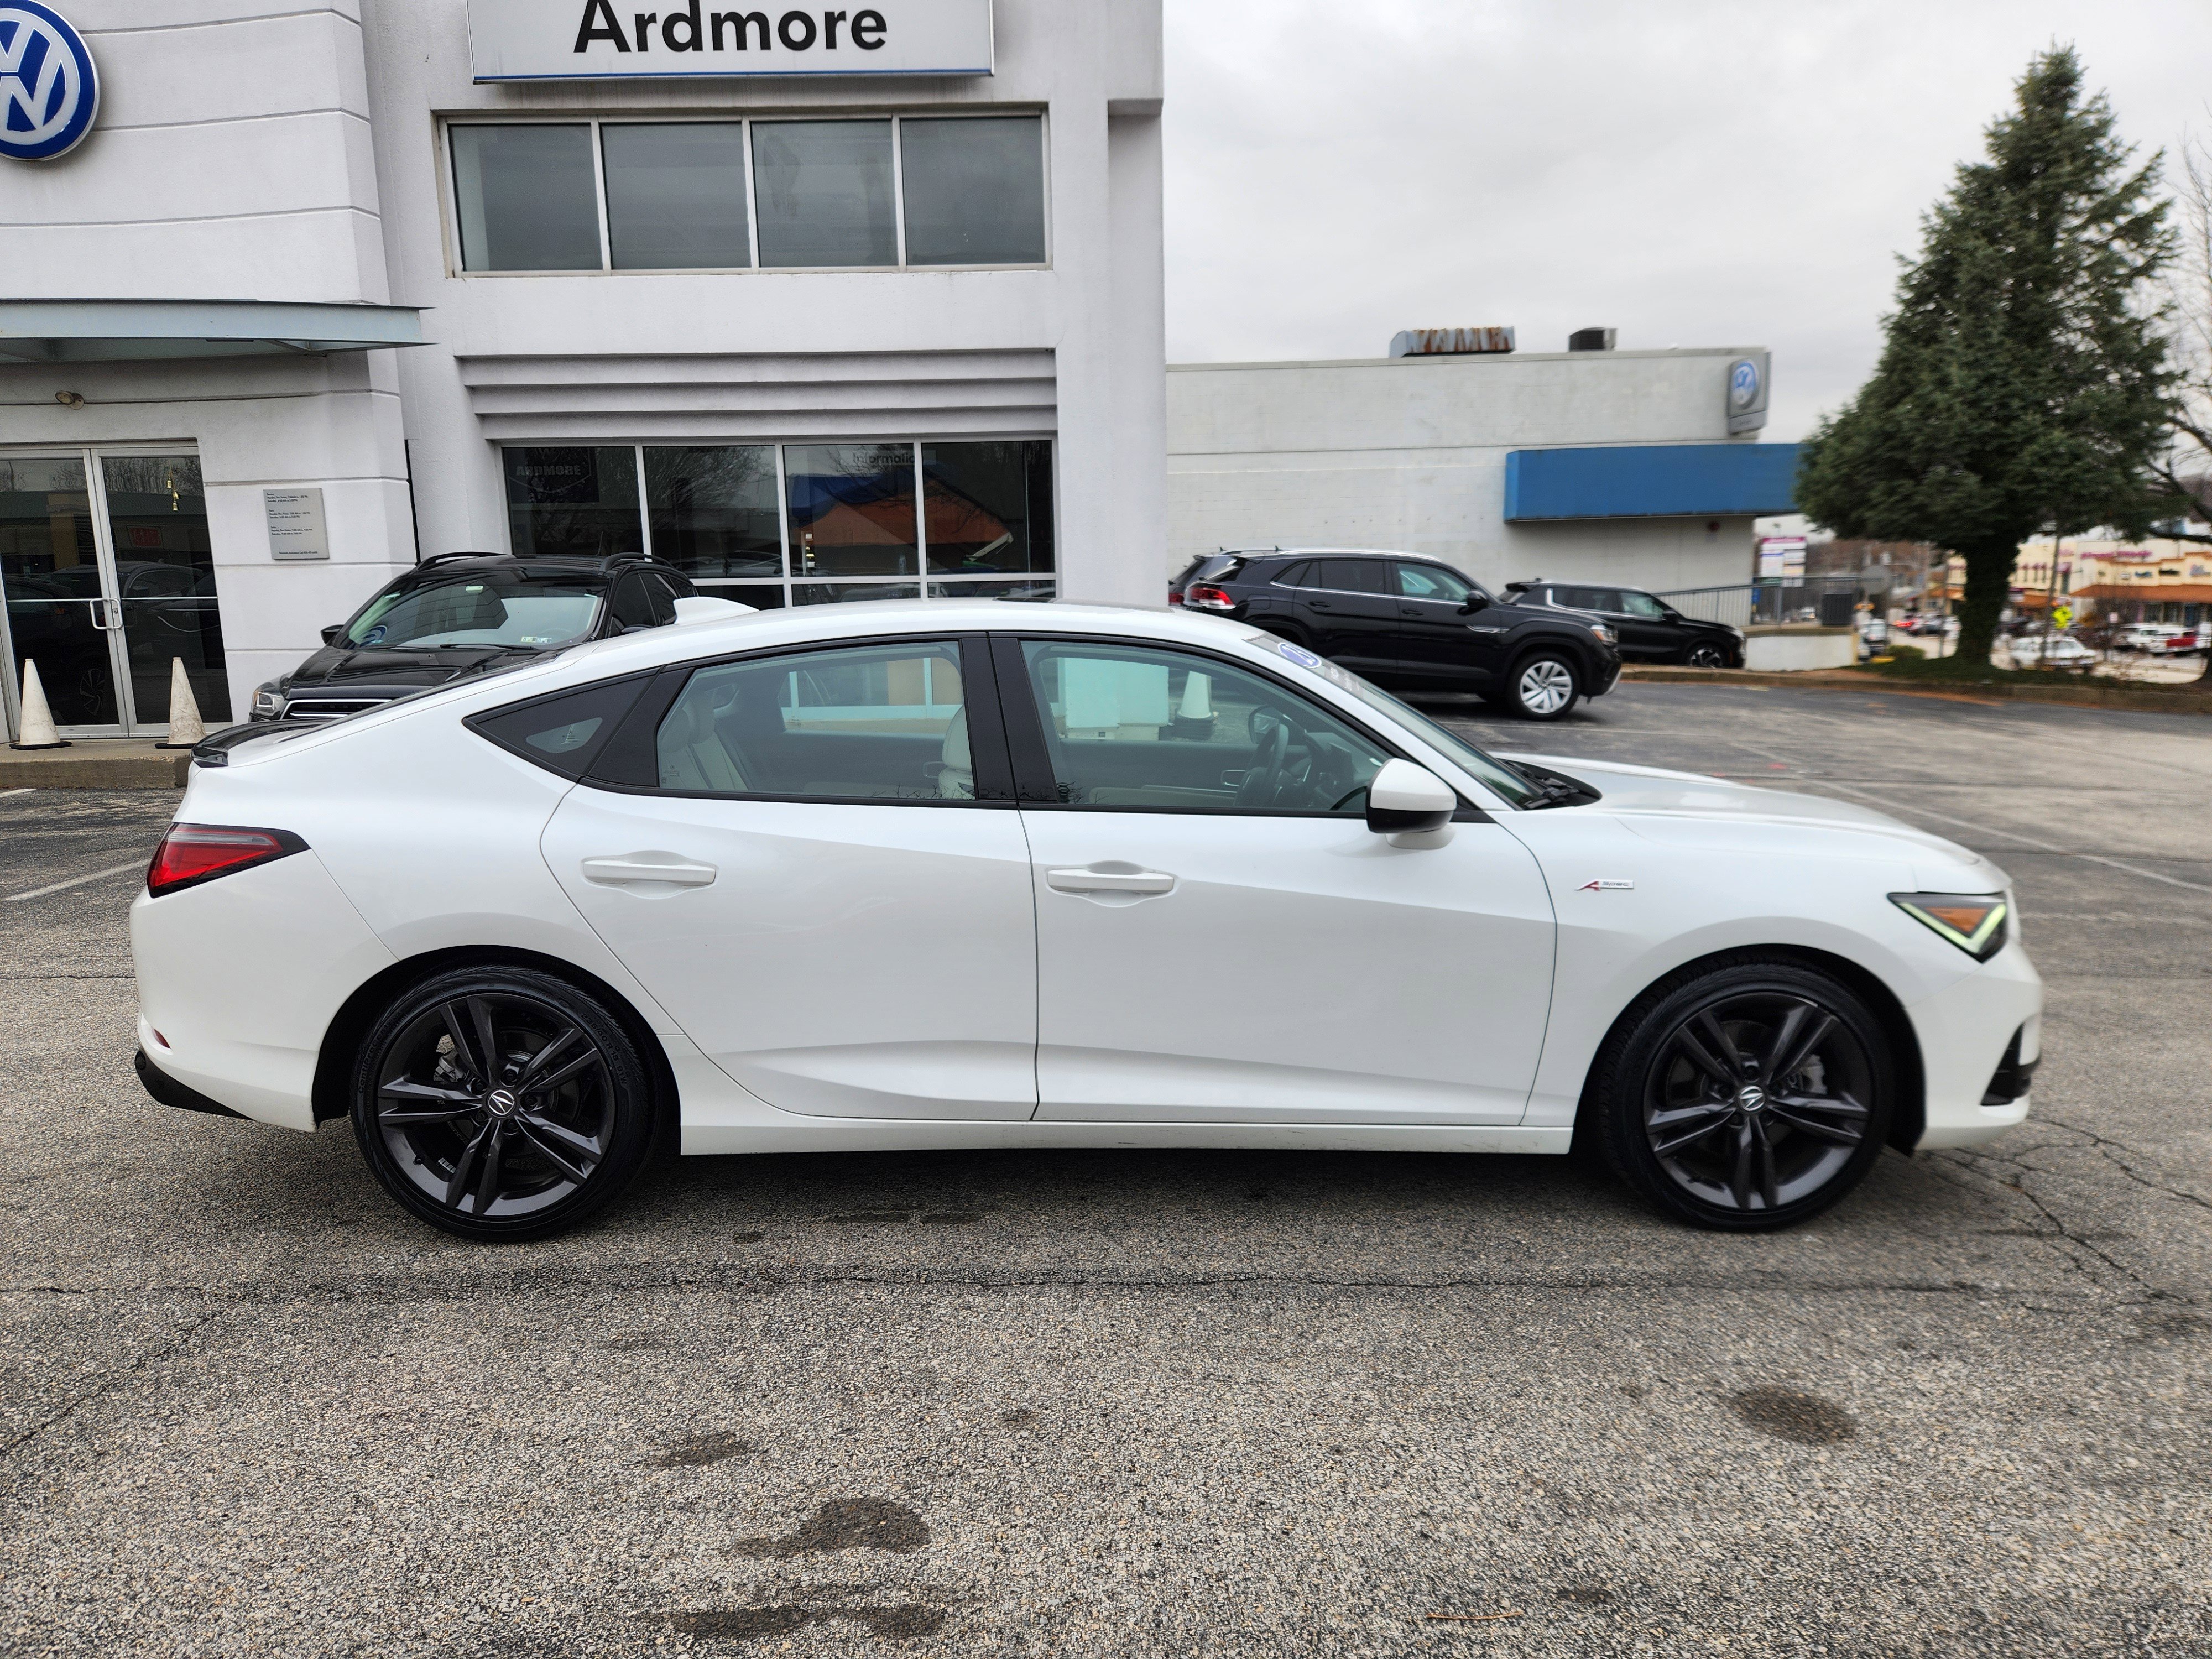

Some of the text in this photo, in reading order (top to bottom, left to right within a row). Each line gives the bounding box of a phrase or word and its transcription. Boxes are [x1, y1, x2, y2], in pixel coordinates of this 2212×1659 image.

[573, 0, 888, 53] Ardmore
[516, 465, 581, 476] ARDMORE
[853, 452, 914, 464] Informatio
[581, 1013, 607, 1041] 235/40
[611, 1051, 619, 1061] 18
